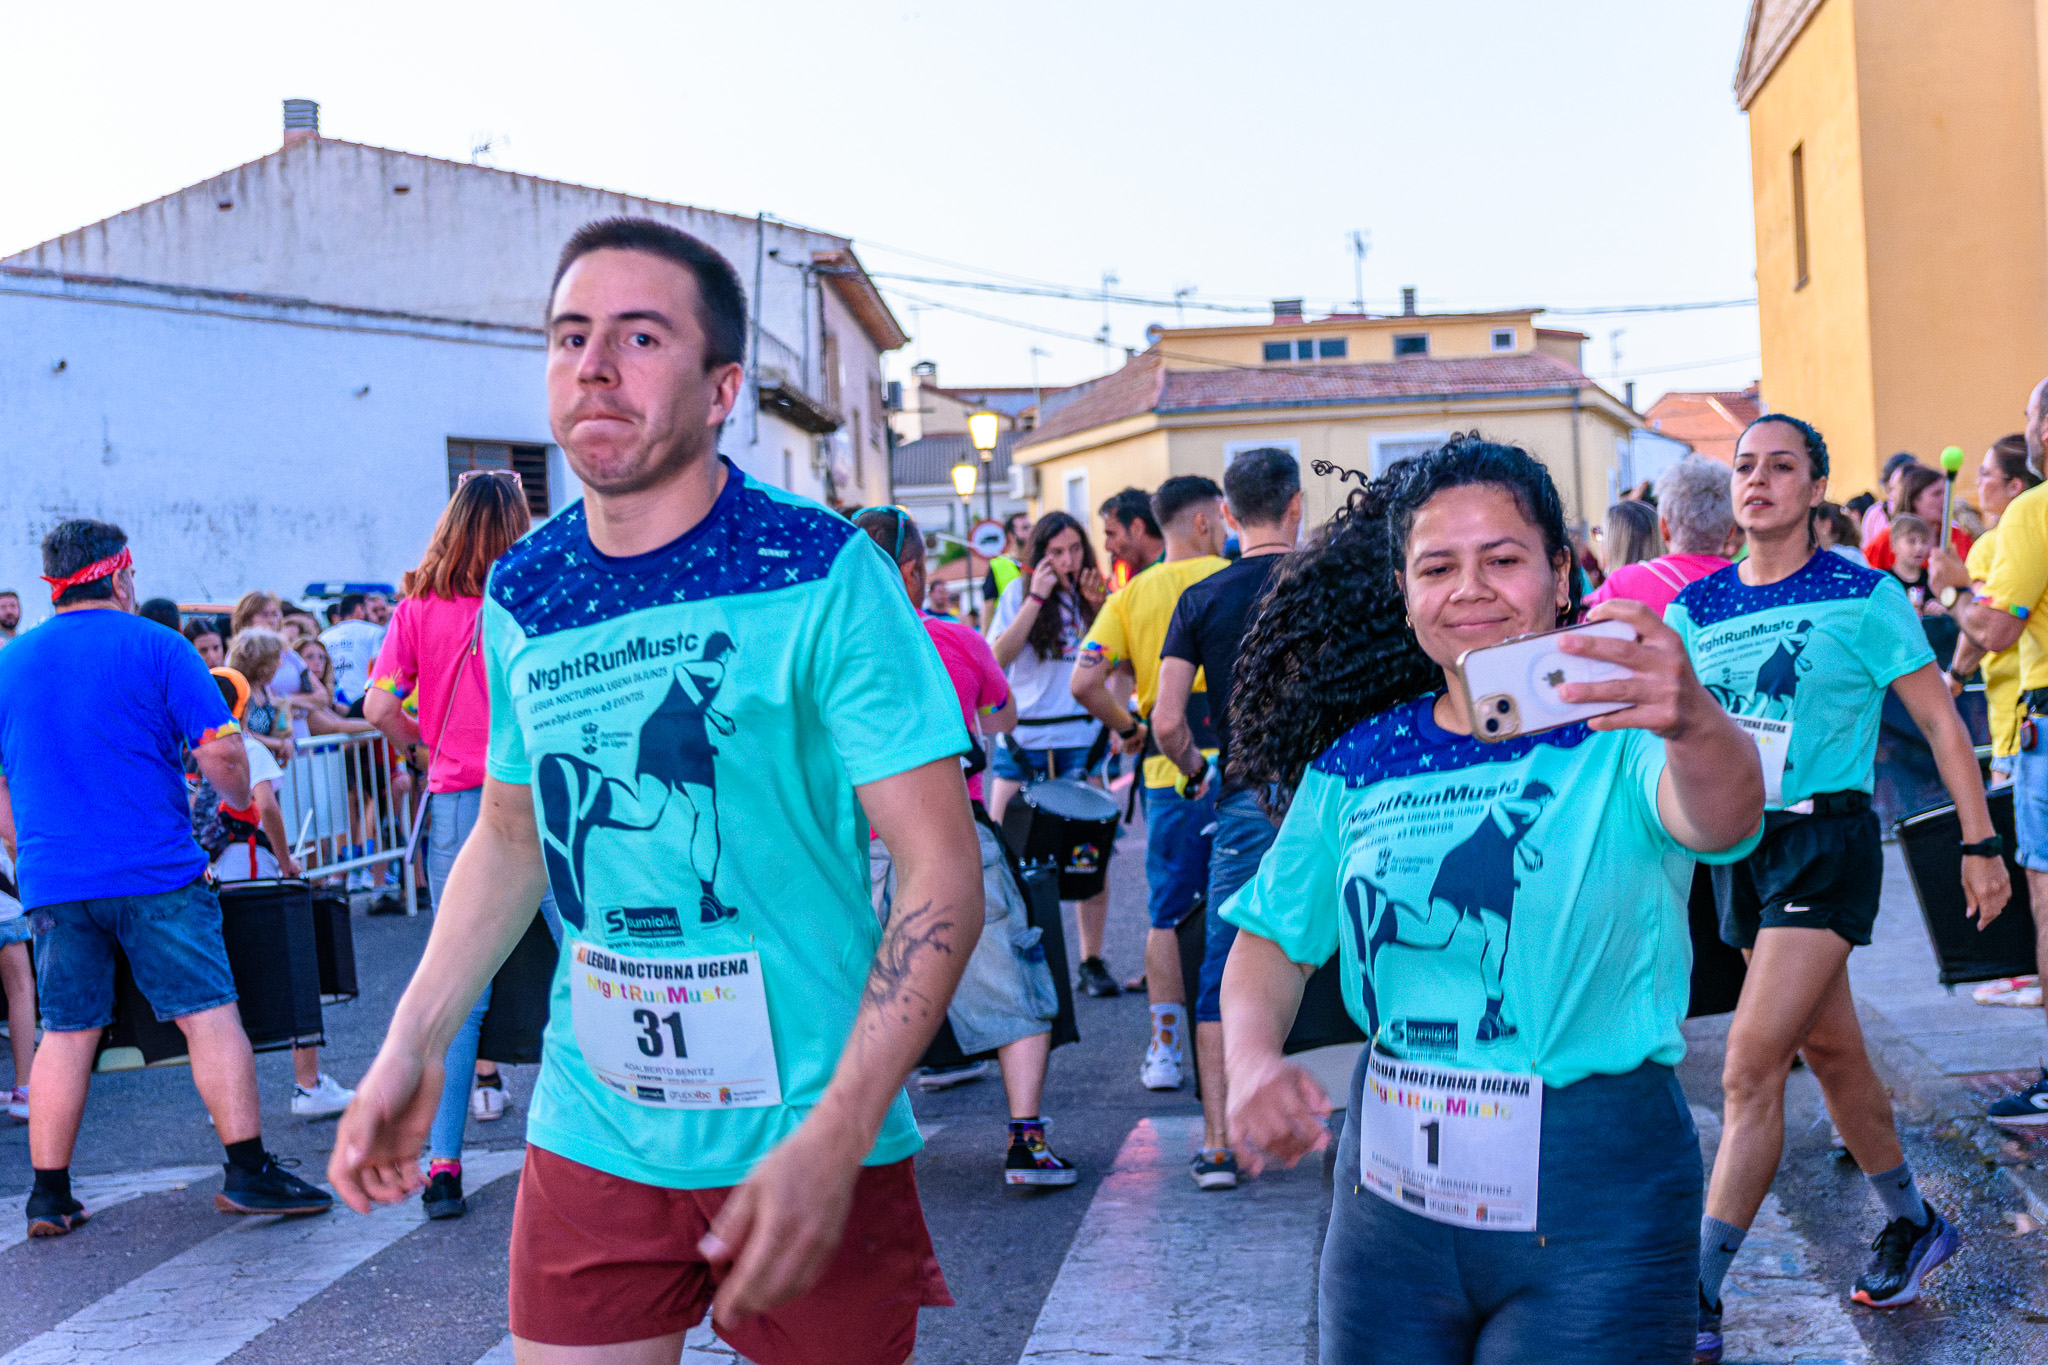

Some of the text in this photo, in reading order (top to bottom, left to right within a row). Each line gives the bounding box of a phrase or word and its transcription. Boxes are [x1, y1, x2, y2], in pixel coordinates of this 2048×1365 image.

[587, 950, 618, 974] LEGUA
[619, 959, 694, 980] NOCTURNA
[698, 958, 749, 979] UGENA
[633, 1007, 688, 1059] 31
[624, 1062, 675, 1076] ADALBERTO
[675, 1067, 715, 1077] BENITEZ
[1400, 1066, 1477, 1091] NOCTURNA
[1420, 1120, 1440, 1168] 1
